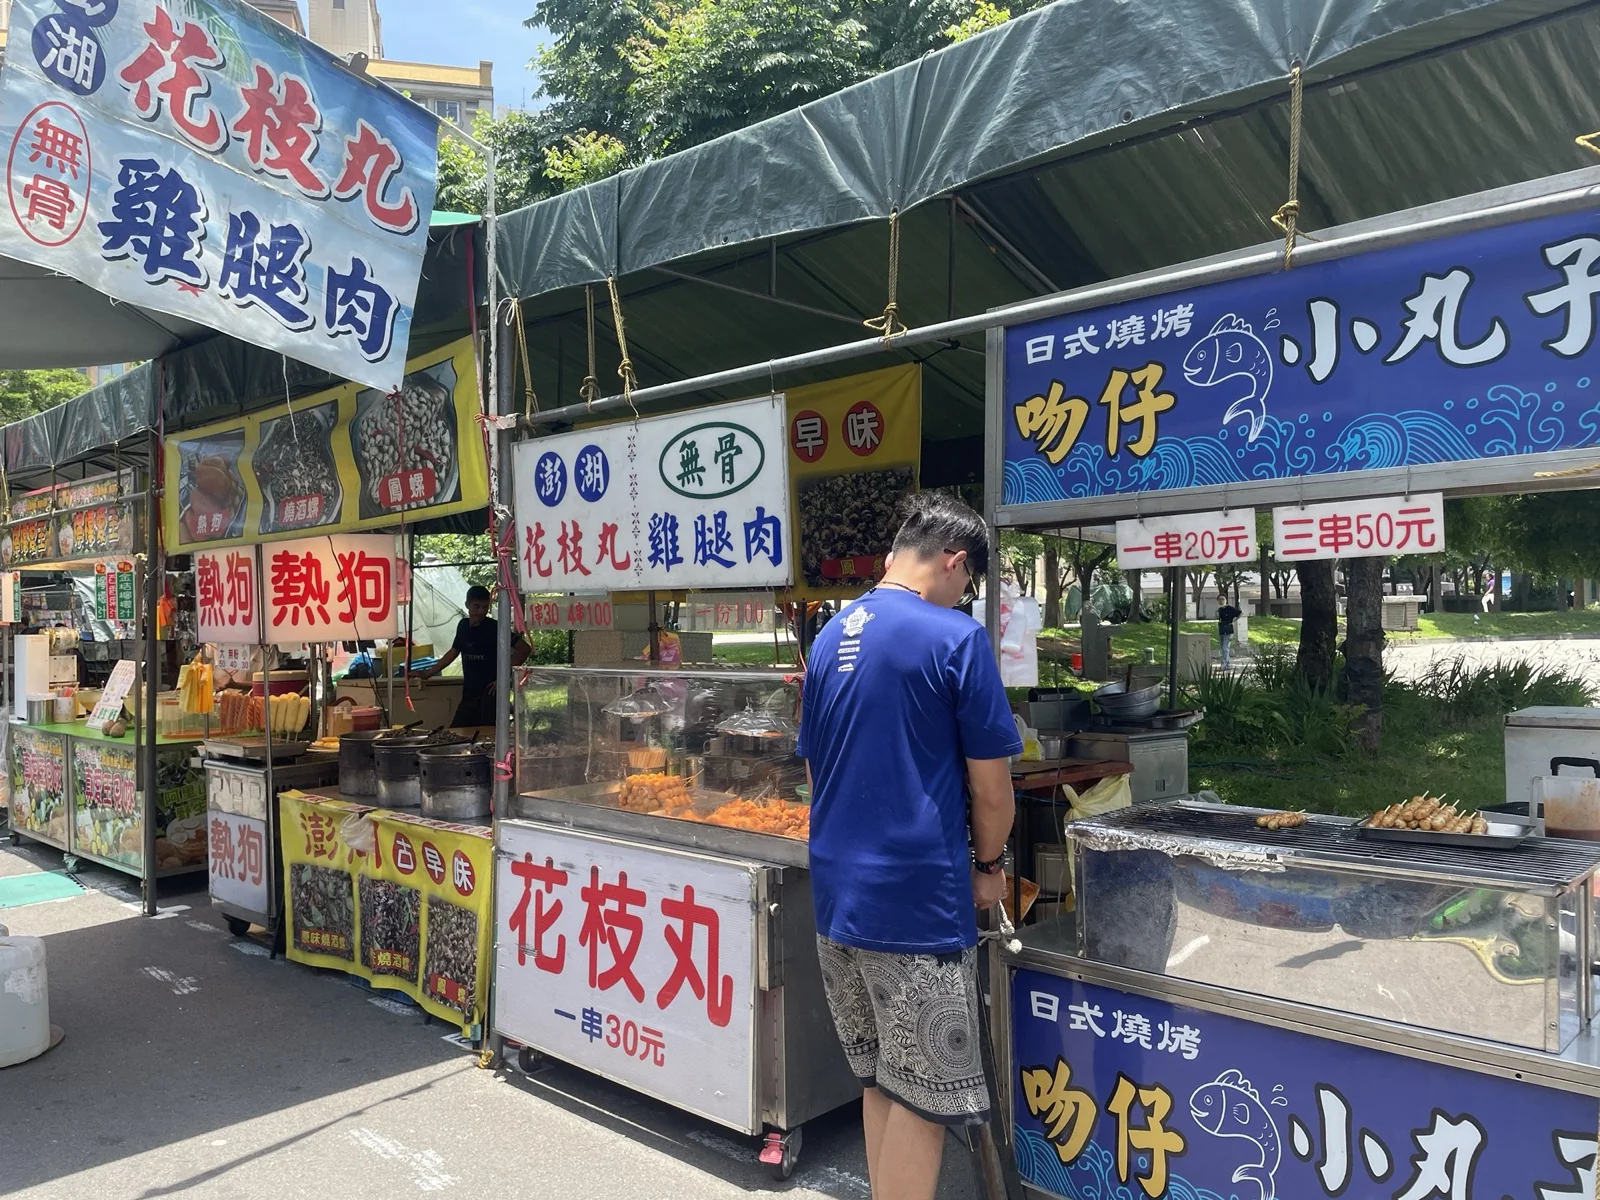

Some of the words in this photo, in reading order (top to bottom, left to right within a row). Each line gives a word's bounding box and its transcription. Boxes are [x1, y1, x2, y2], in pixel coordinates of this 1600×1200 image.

[119, 5, 415, 230] 花枝丸
[22, 117, 83, 231] 無骨
[97, 158, 394, 355] 雞腿肉
[1025, 302, 1195, 365] 日式燒烤
[1280, 236, 1600, 383] 小丸子
[795, 407, 880, 458] 早味
[1015, 361, 1176, 466] 吻仔
[387, 472, 426, 503] 鳳螺
[539, 452, 605, 502] 澎湖
[676, 432, 743, 487] 無骨
[196, 512, 223, 535] 熱狗
[282, 496, 319, 523] 燒酒螺
[648, 506, 782, 572] 雞腿肉
[1281, 507, 1436, 555] 三串50元
[523, 519, 631, 579] 花枝丸
[1122, 525, 1250, 564] 一串20元
[197, 550, 254, 628] 熱狗
[271, 549, 392, 627] 熱狗
[696, 601, 764, 625] 一份100
[210, 817, 263, 886] 熱狗
[395, 837, 474, 892] 古早味
[508, 851, 734, 1028] 花枝丸
[553, 1006, 666, 1067] 一串30元
[1029, 991, 1202, 1060] 日式燒烤
[1020, 1057, 1187, 1200] 吻仔
